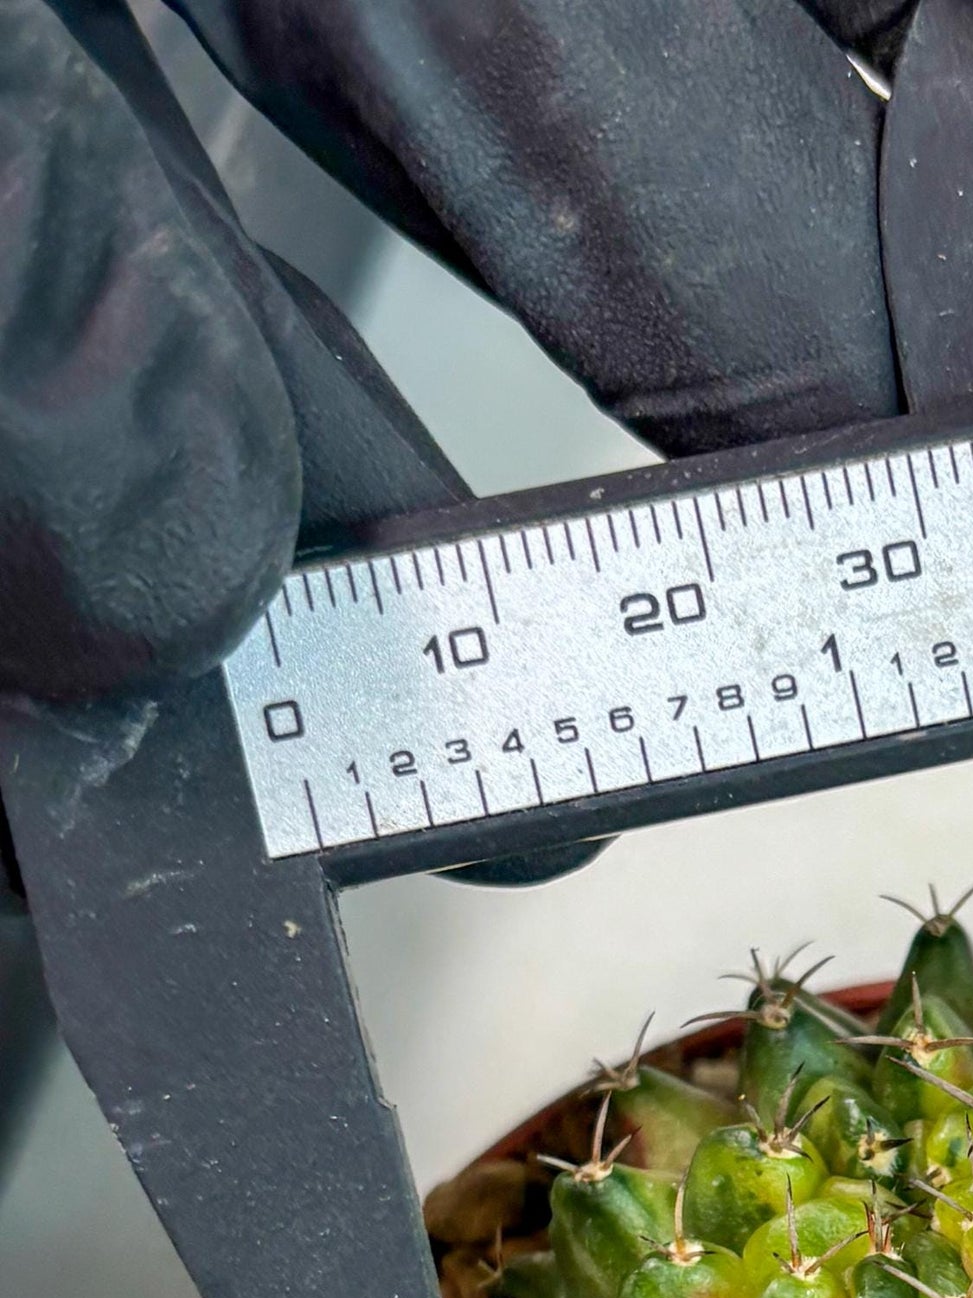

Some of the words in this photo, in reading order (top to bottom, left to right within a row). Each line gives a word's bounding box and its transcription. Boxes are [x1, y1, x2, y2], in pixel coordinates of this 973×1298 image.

[263, 700, 304, 742] 0
[423, 626, 489, 674] 10
[619, 583, 706, 636] 20
[836, 540, 922, 591] 30
[346, 761, 360, 784] 1
[389, 750, 418, 777] 2
[445, 739, 472, 764] 3
[502, 728, 524, 754] 4
[554, 717, 579, 744] 5
[609, 706, 635, 733] 6
[667, 695, 688, 720] 7
[716, 684, 745, 711] 8
[771, 674, 798, 702] 9
[820, 633, 842, 673] 1
[890, 652, 904, 676] 1
[932, 641, 959, 668] 2
